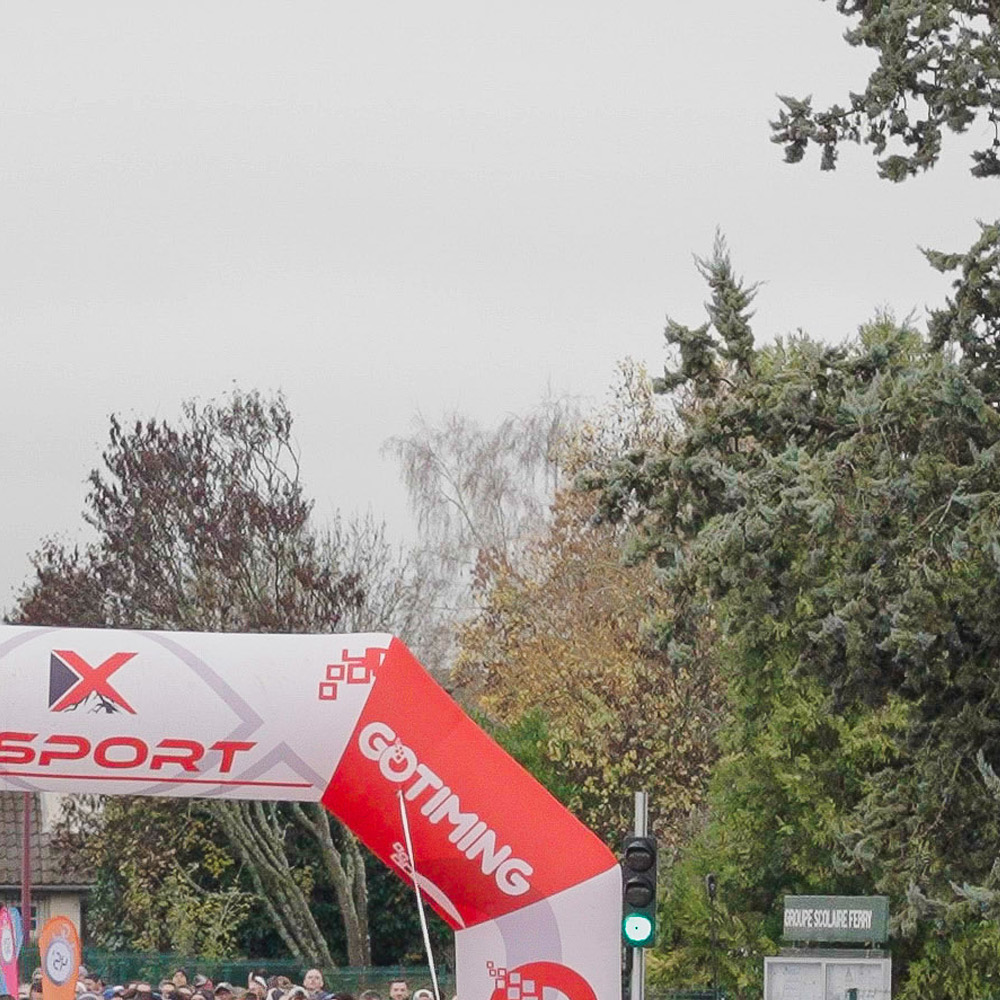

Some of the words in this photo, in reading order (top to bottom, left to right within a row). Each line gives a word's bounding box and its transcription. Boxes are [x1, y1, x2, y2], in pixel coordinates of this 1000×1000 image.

[358, 722, 533, 895] GOTIMING
[784, 909, 813, 927] GROUPE
[814, 909, 848, 928] SCOLAIRE
[849, 909, 873, 929] FERRY
